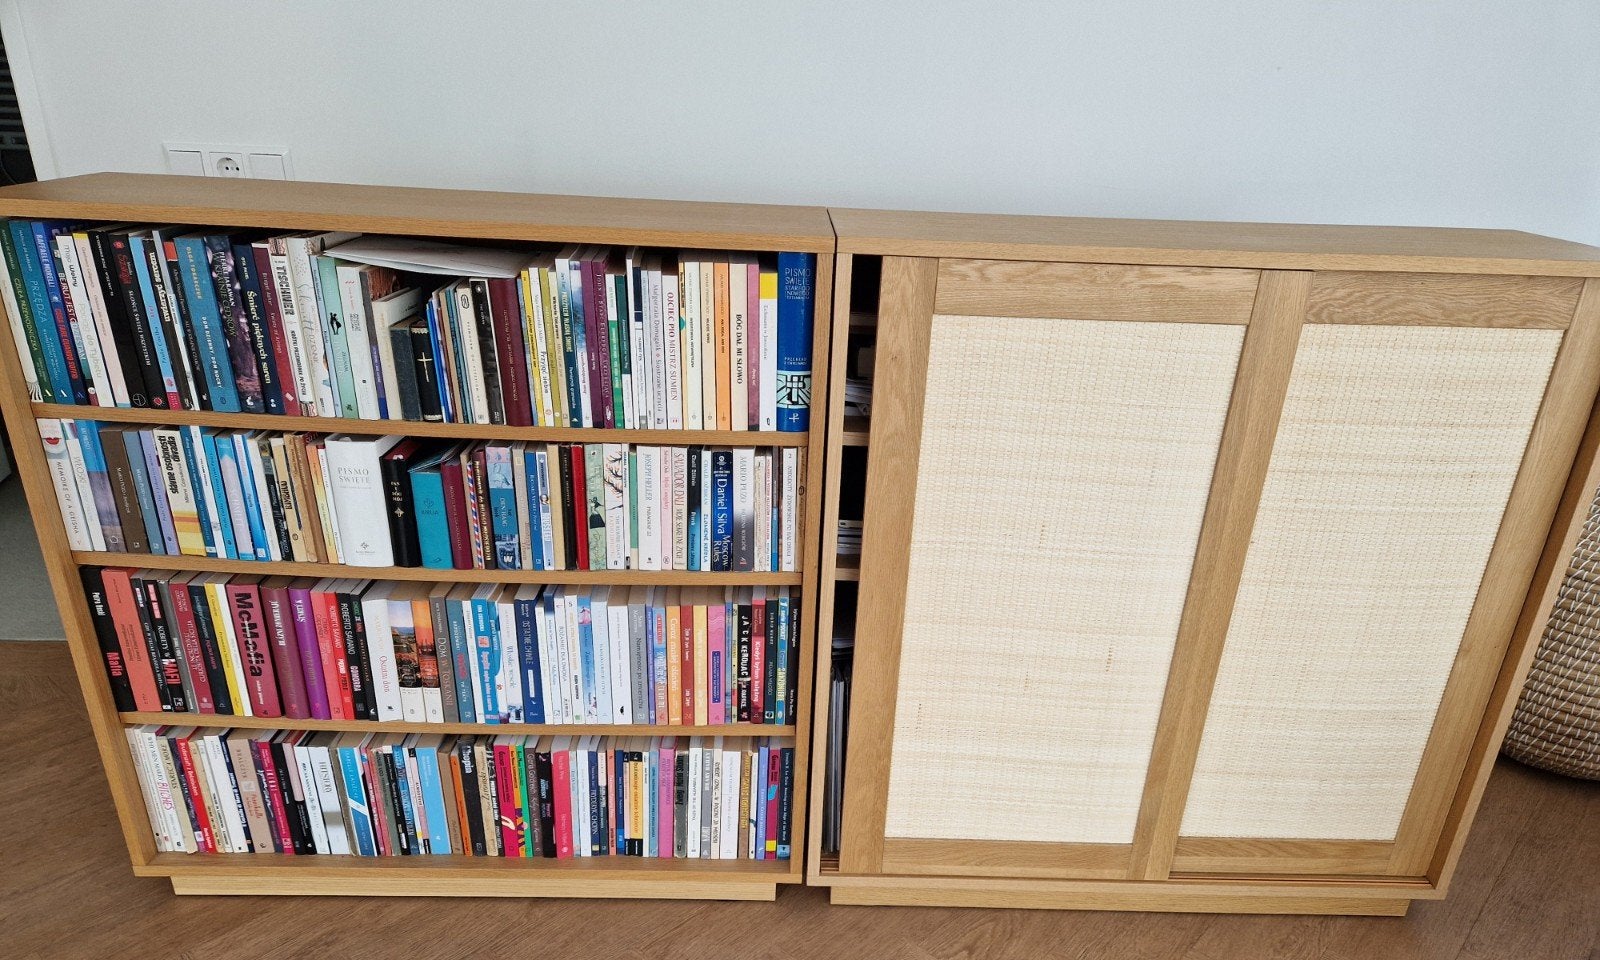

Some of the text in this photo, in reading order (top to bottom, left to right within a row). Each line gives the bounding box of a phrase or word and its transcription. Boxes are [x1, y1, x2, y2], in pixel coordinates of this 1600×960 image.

[36, 233, 55, 287] RAFFAELE MORELLI
[67, 263, 79, 288] Wolny
[785, 268, 810, 277] PISMO
[276, 265, 294, 315] TISCHNER
[666, 291, 674, 321] OJCIEC
[246, 290, 272, 384] Śmierć pięknych saren
[651, 284, 663, 412] Małgorzata Domagalik Siostrzane uczucia
[668, 339, 676, 368] MISTRZ
[669, 370, 677, 400] SUMIEŃ
[156, 434, 179, 494] slávne osobnosti
[166, 435, 181, 462] divadla
[338, 467, 369, 475] PISMO
[643, 454, 652, 500] JOSEPH HELLER
[673, 452, 685, 506] SALVADOR DALI
[739, 456, 747, 480] MARIO
[56, 461, 68, 490] MEMOIRS
[68, 511, 78, 534] GEISHA
[716, 478, 726, 533] Daniel Silva
[712, 540, 720, 562] Rules
[721, 534, 730, 565] Moscow
[157, 624, 169, 650] KOBIETY
[234, 591, 266, 677] McMafia
[329, 606, 341, 648] ROBERTO SAVIANO
[340, 602, 355, 655] ROBERTO SAVIANO
[740, 615, 749, 675] JACK KEROUAC
[105, 650, 123, 676] Mafia
[162, 657, 180, 685] MAFII
[350, 664, 361, 691] GOMORRA
[441, 670, 452, 705] TOSKANII
[319, 760, 331, 793] HITSTORY
[158, 779, 174, 811] BITCHES
